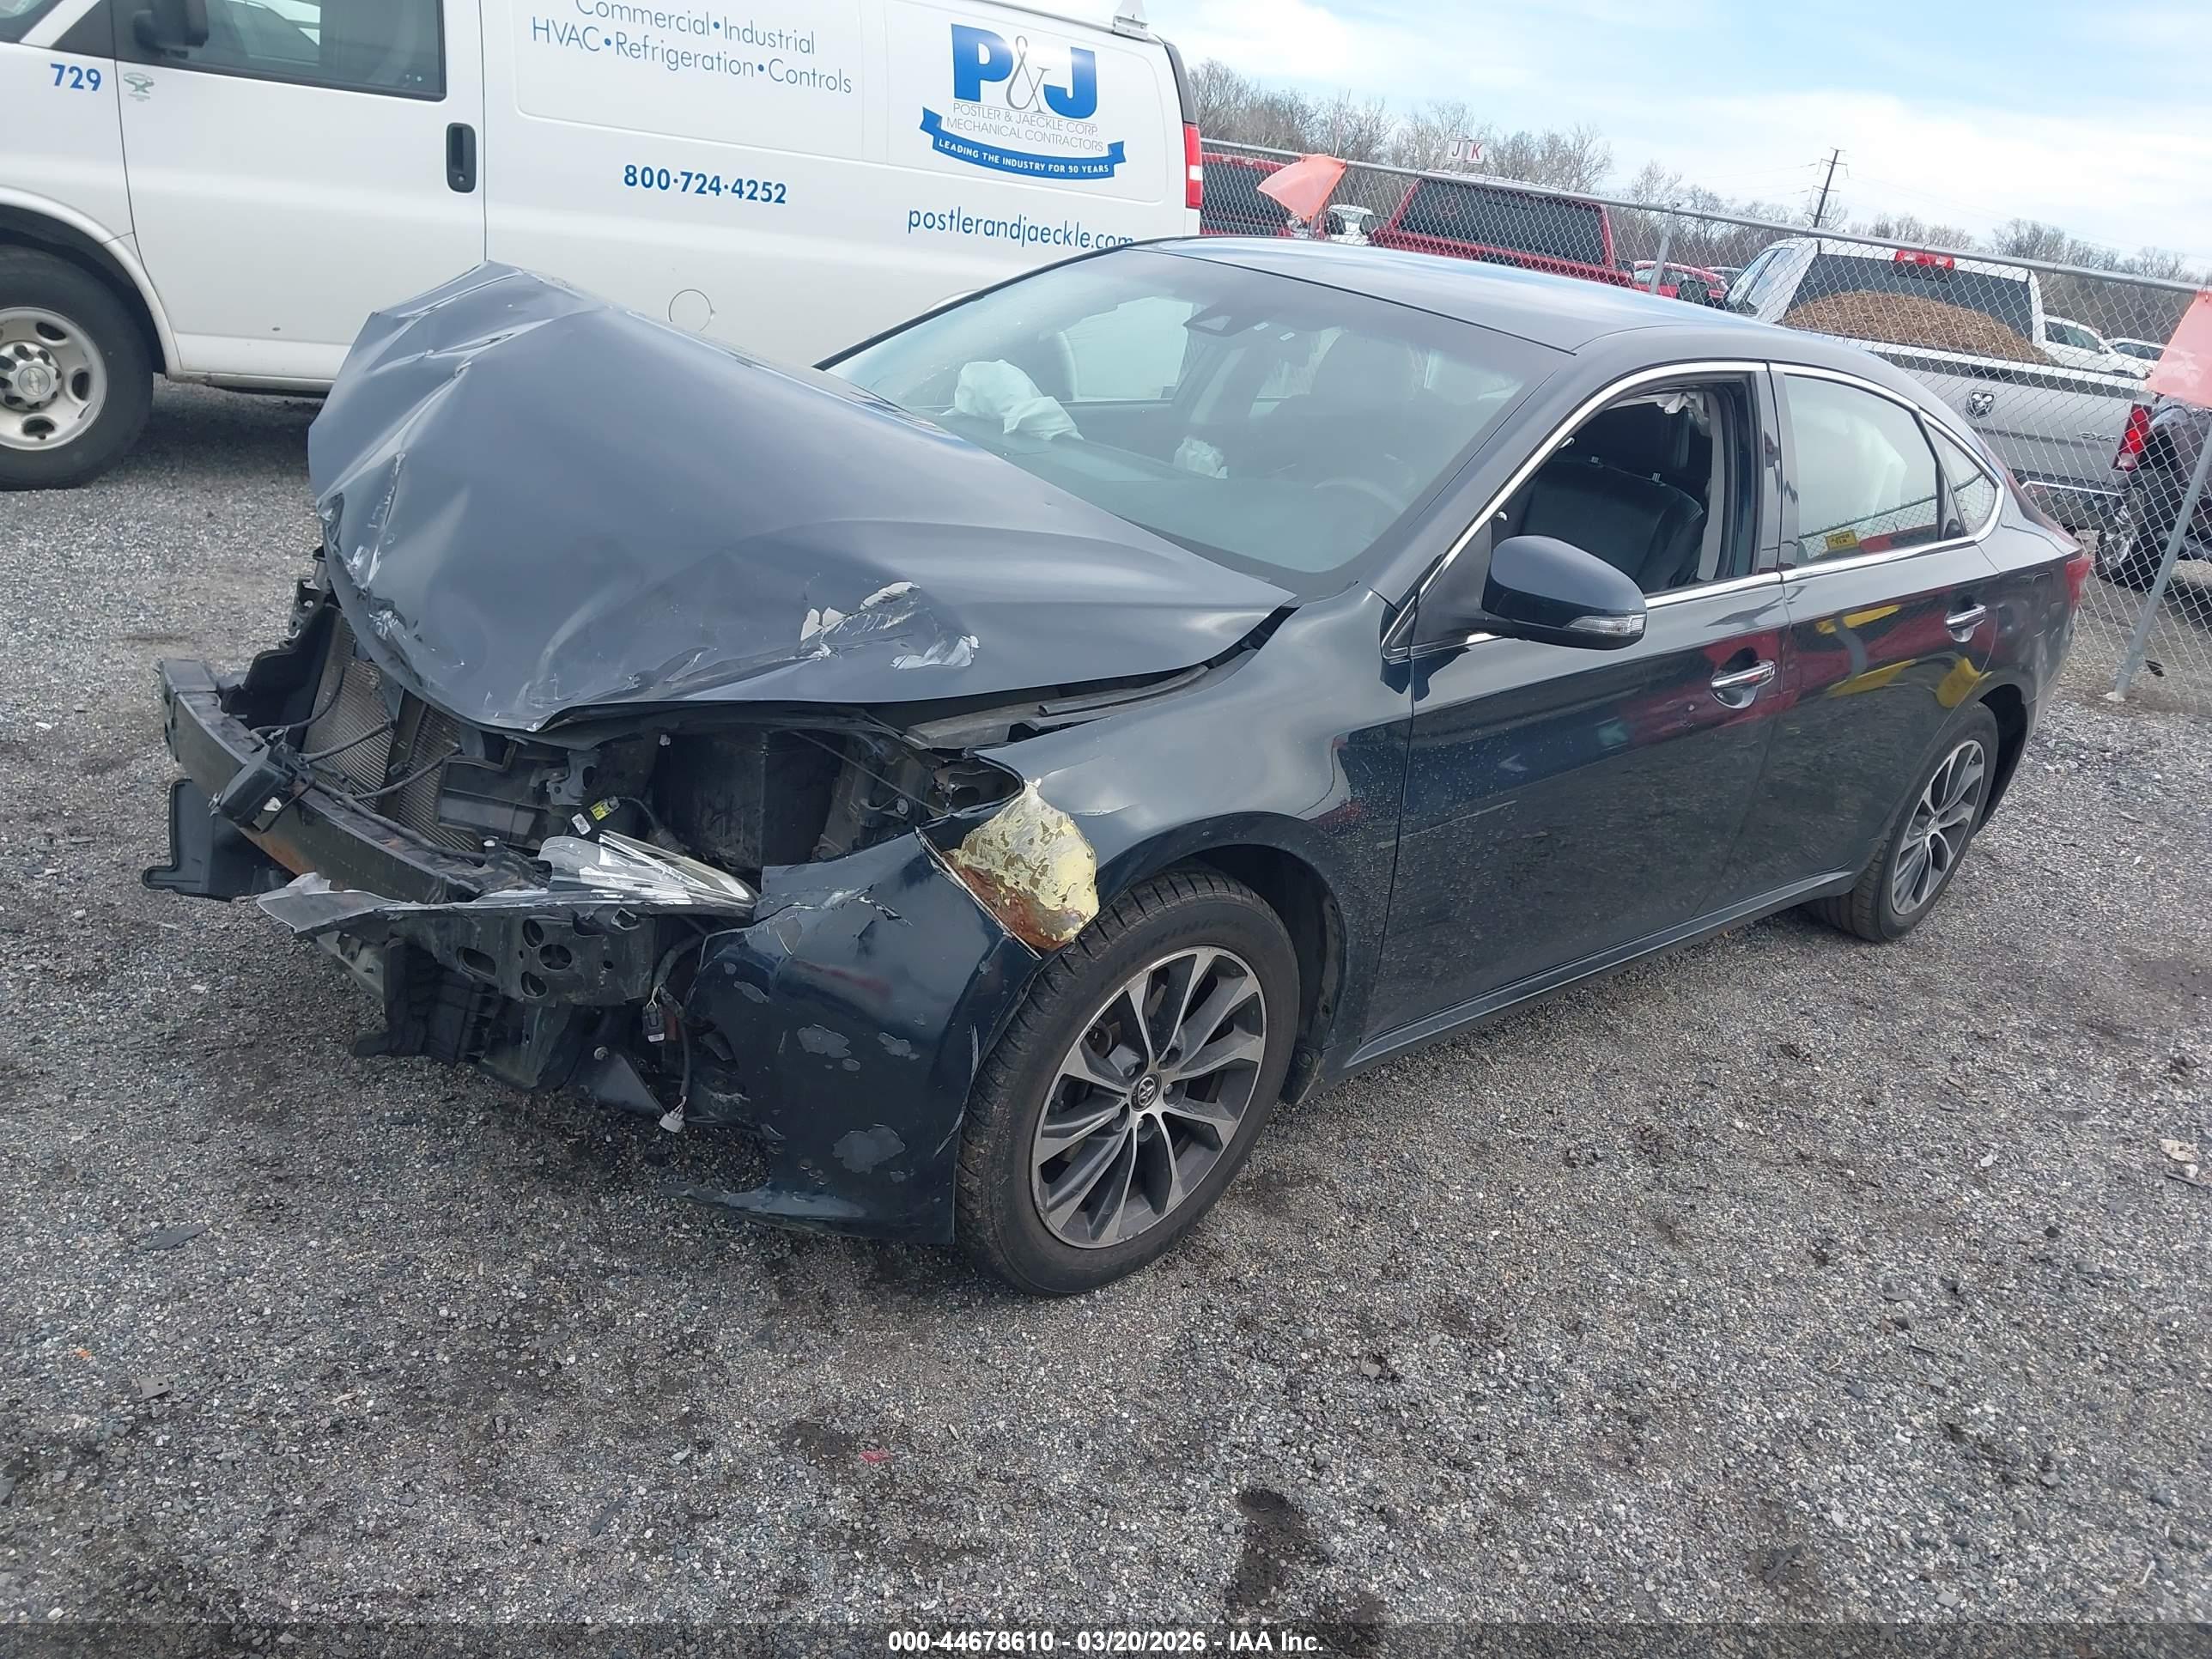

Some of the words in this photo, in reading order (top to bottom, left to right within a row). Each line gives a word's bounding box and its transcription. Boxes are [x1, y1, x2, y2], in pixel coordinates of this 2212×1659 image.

[50, 63, 102, 92] 729
[946, 117, 1023, 139] MECHANICAL
[1024, 129, 1103, 153] CONTRACTORS
[953, 102, 1001, 120] POSTLER
[1004, 111, 1012, 123] &
[1016, 113, 1063, 131] JAECKLE
[1066, 122, 1098, 137] CORP.
[939, 138, 979, 158] LEADING
[981, 152, 1000, 164] THE
[1002, 157, 1046, 171] INDUSTRY
[1048, 164, 1066, 173] FOR
[1082, 164, 1109, 173] YEARS
[1451, 142, 1461, 156] J
[1471, 143, 1482, 159] K
